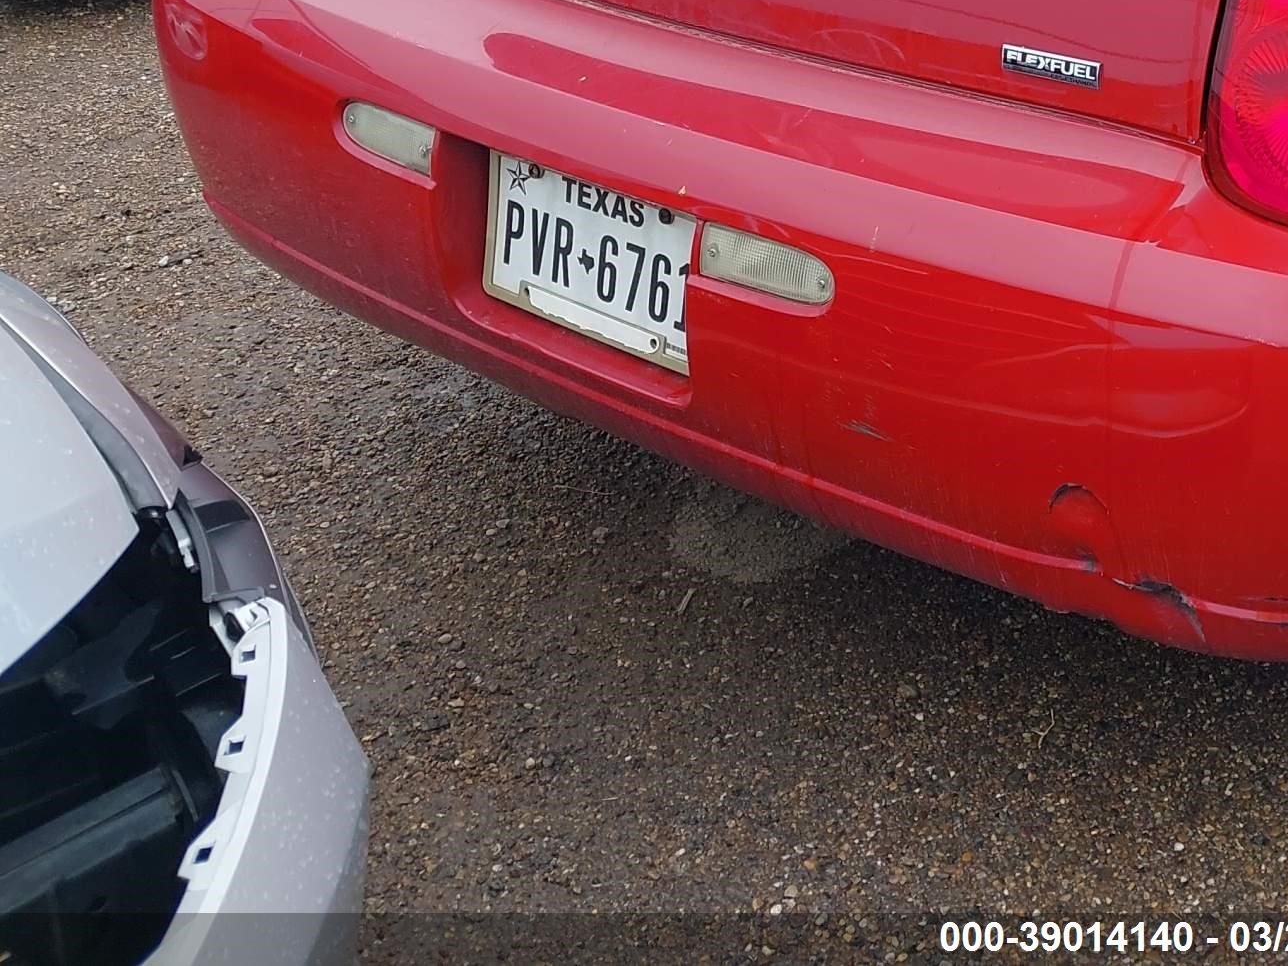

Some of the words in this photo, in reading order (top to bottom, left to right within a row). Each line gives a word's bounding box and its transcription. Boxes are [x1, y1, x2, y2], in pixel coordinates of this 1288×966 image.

[1006, 50, 1096, 80] FLEXFUEL
[562, 176, 645, 227] TEXAS
[503, 199, 574, 288] PVR
